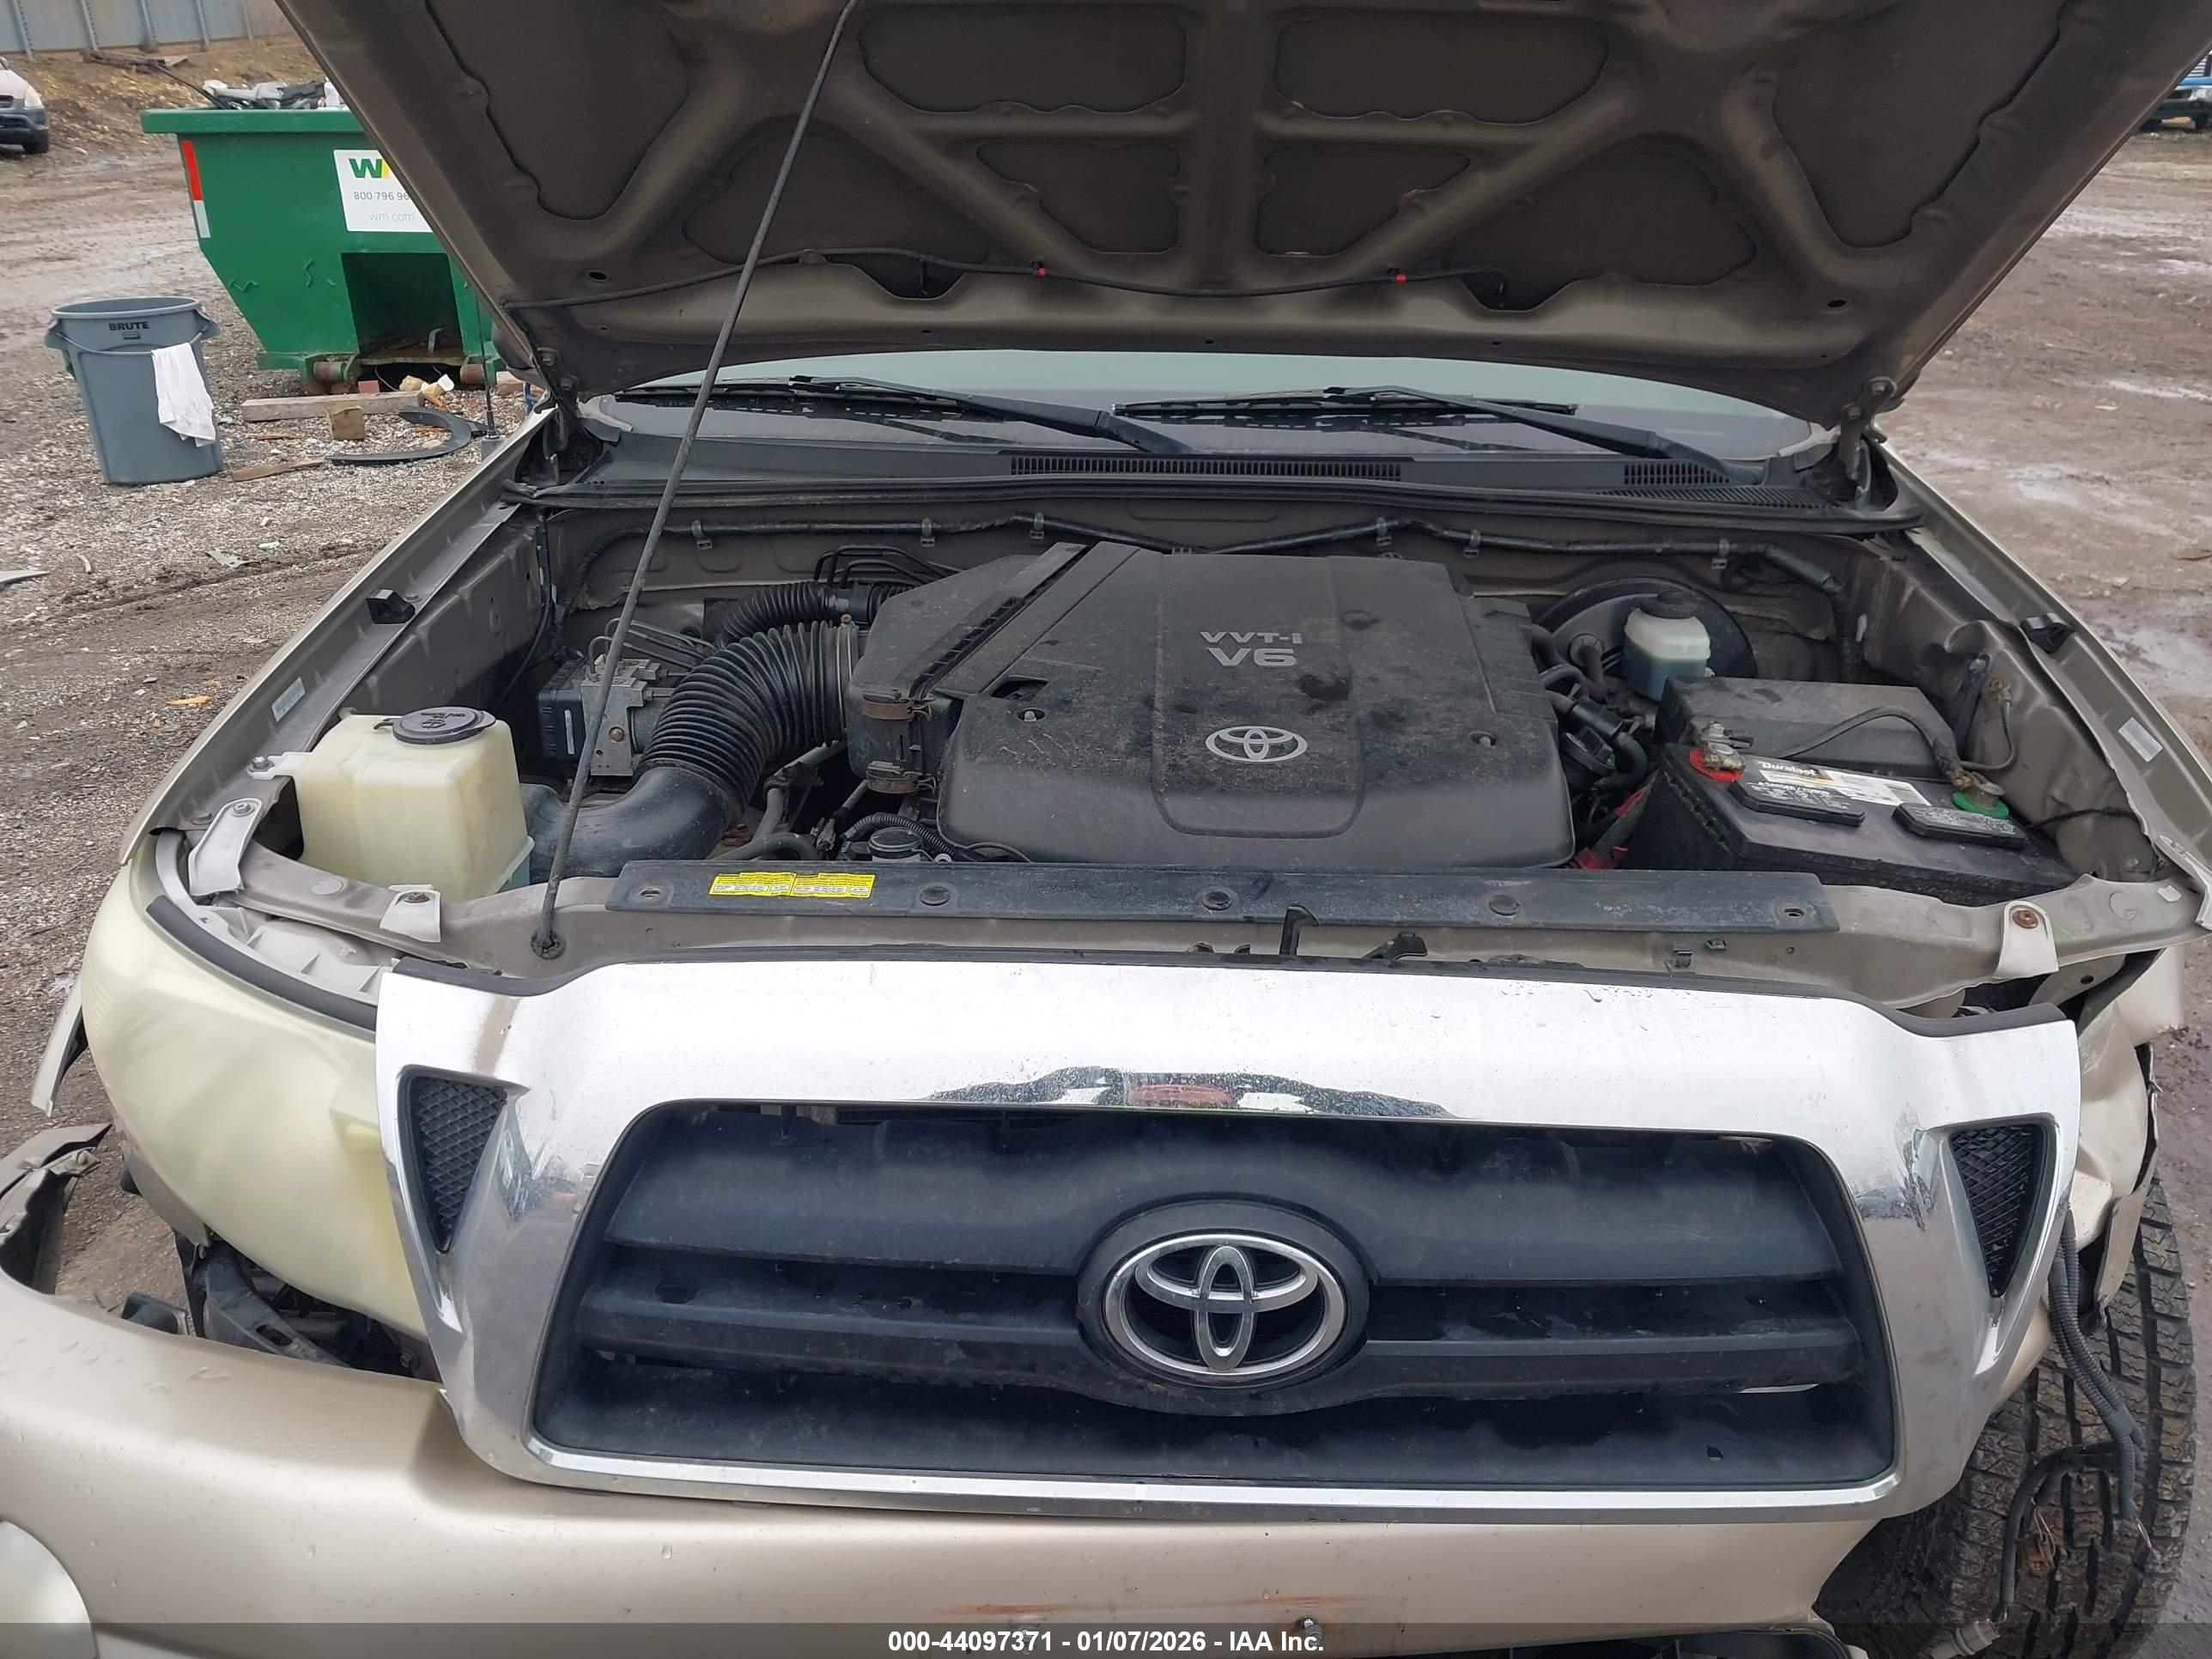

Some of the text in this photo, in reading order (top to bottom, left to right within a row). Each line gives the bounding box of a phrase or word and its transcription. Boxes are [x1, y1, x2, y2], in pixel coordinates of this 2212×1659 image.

[348, 158, 389, 179] W
[354, 191, 410, 200] 800 796 96
[369, 213, 415, 222] wm.com
[108, 321, 149, 331] BRUTE
[1206, 647, 1297, 666] V6
[1758, 761, 1818, 777] Duralast
